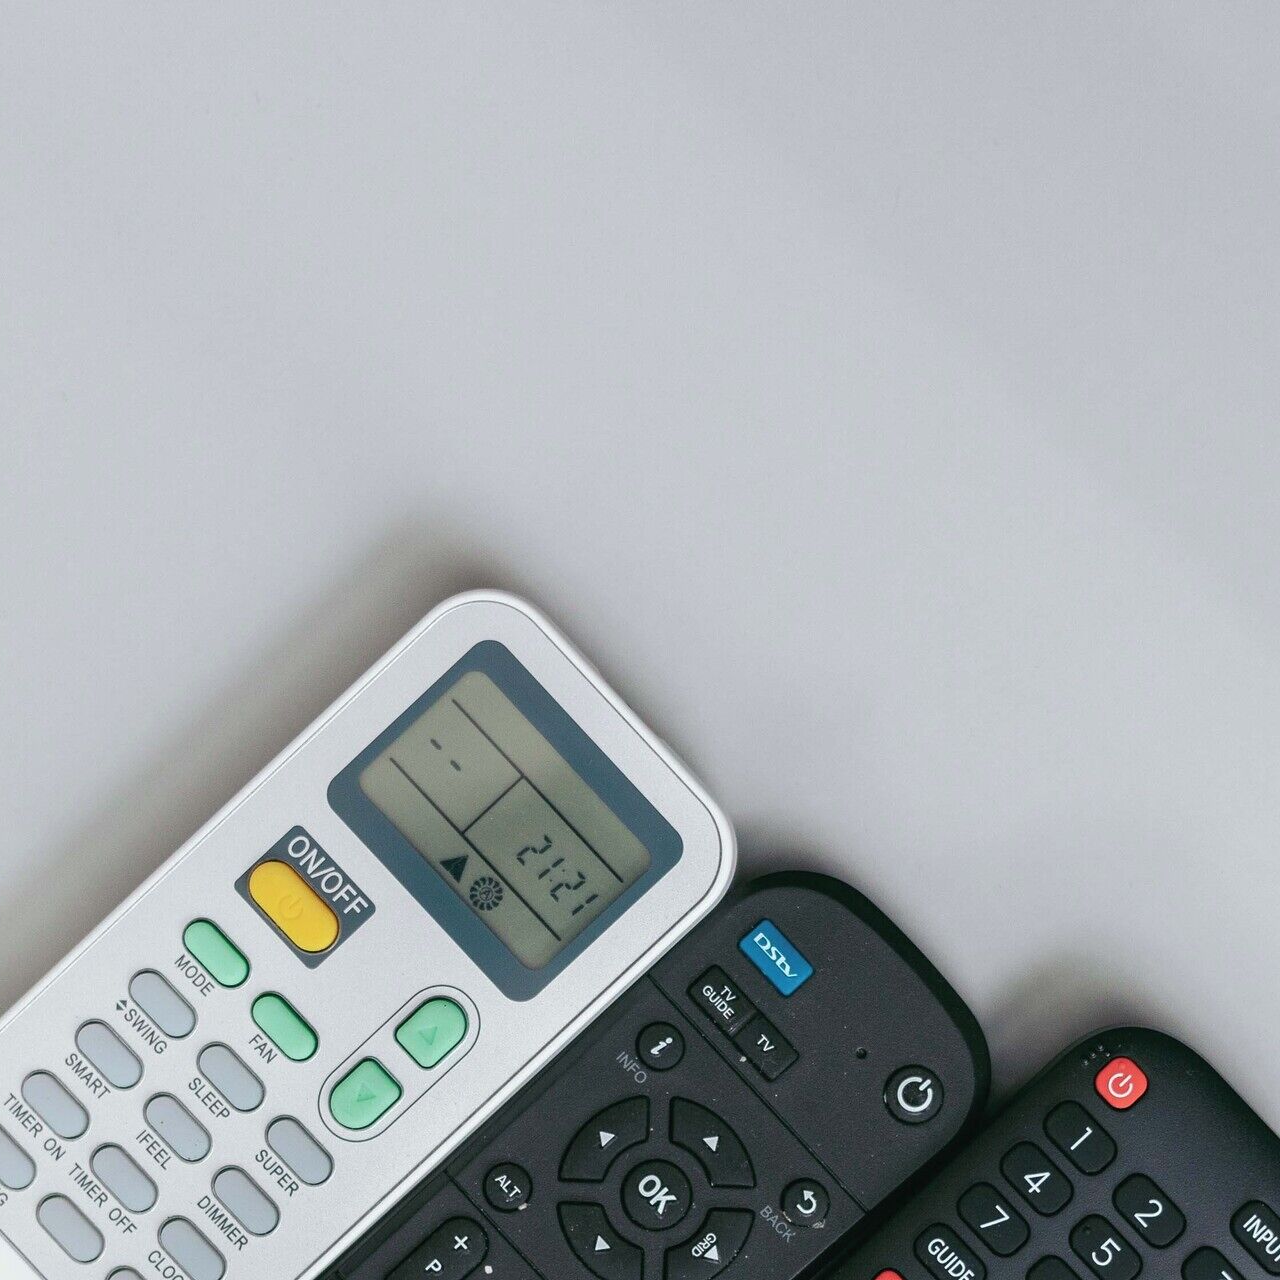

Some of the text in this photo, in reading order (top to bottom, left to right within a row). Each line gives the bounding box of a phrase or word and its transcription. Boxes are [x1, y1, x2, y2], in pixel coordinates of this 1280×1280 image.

[288, 835, 368, 916] ON/OFF
[174, 954, 215, 997] MODE
[702, 985, 734, 1020] GUIDE
[721, 985, 737, 1002] TV
[124, 1008, 168, 1054] SWING
[757, 1034, 775, 1053] TV
[248, 1034, 278, 1064] FAN
[65, 1053, 111, 1099] SMART
[616, 1051, 647, 1085] INFO
[188, 1077, 230, 1119] SLEEP
[3, 1094, 66, 1161] TIMER ON
[1071, 1127, 1092, 1150] 1
[136, 1129, 173, 1171] IFEEL
[255, 1149, 300, 1197] SUPER
[495, 1174, 521, 1200] ALT
[1024, 1172, 1051, 1193] 4
[68, 1163, 138, 1237] TIMER OFF
[638, 1175, 676, 1215] OK
[196, 1195, 249, 1251] DIMMER
[759, 1205, 797, 1243] BACK
[980, 1206, 1010, 1229] 7
[1134, 1199, 1163, 1228] 2
[692, 1233, 716, 1257] GRID
[1092, 1238, 1121, 1267] 5
[426, 1259, 442, 1274] P
